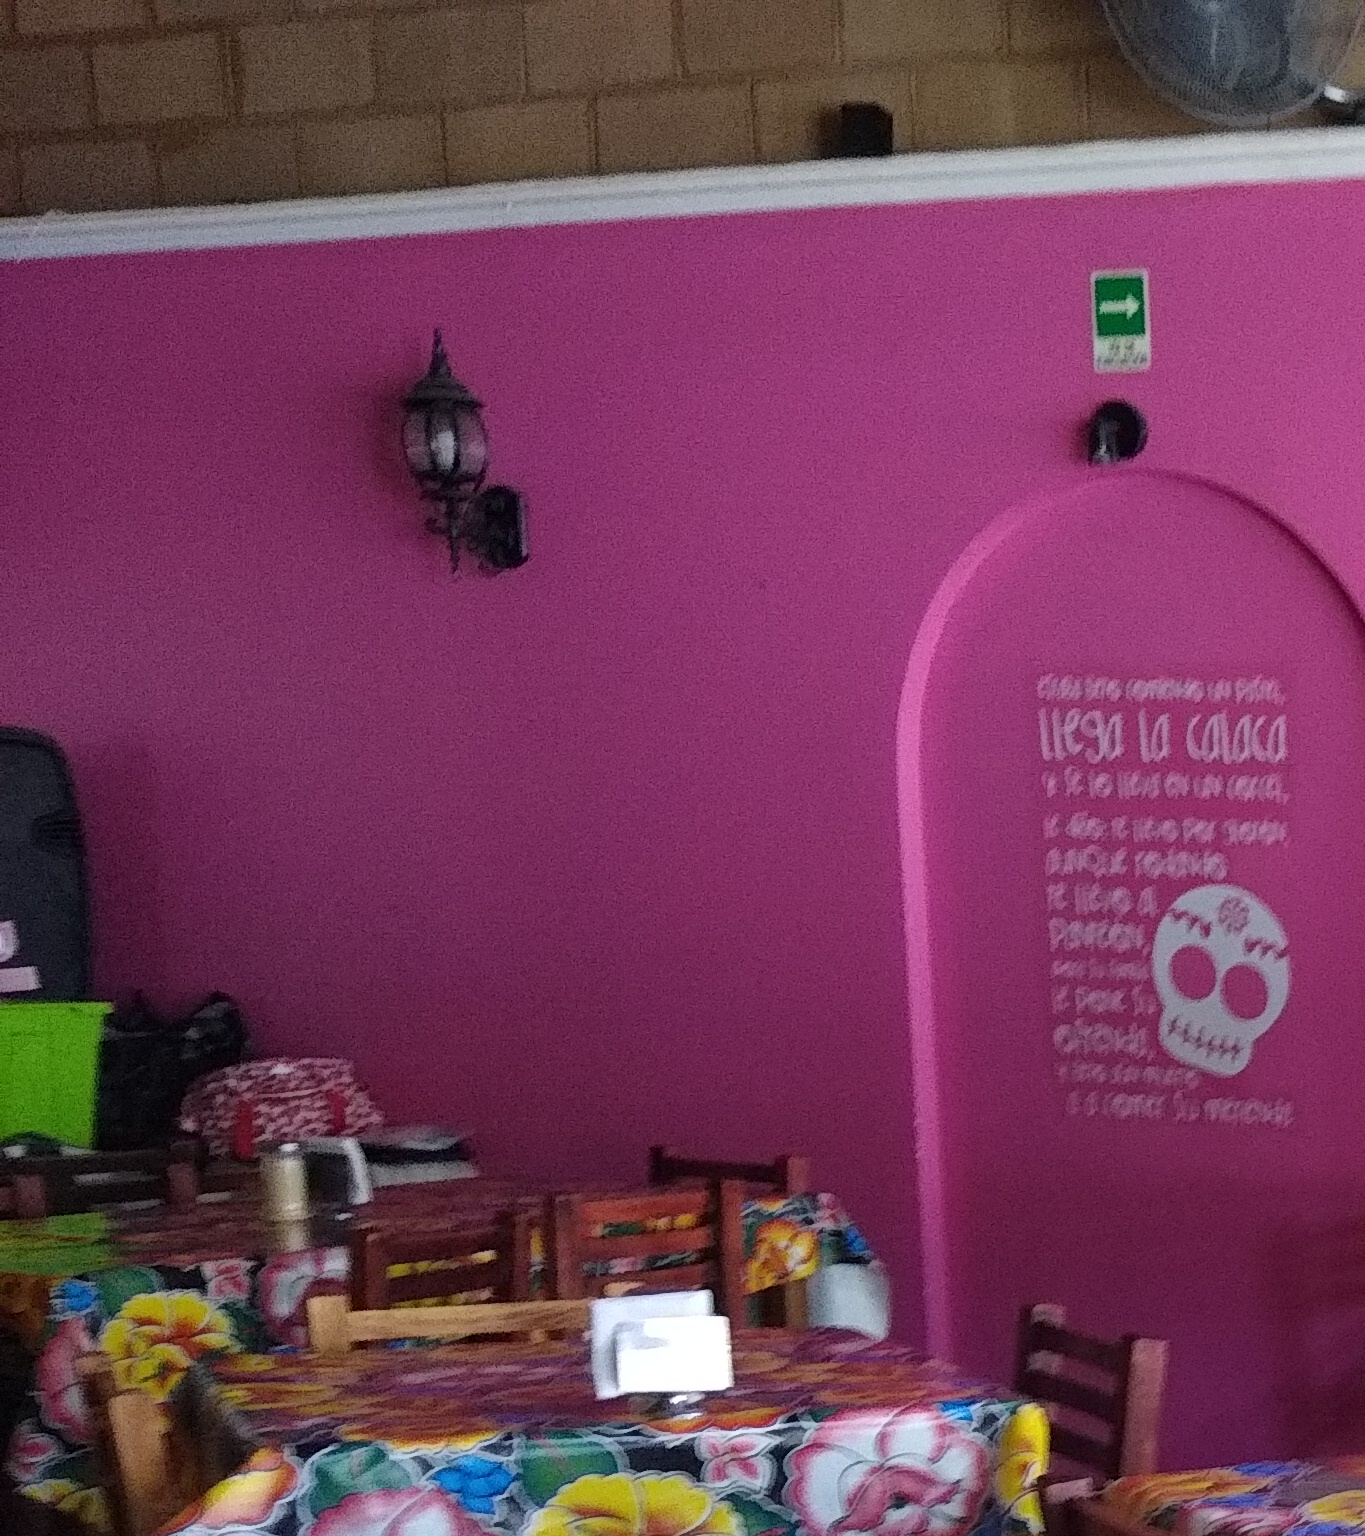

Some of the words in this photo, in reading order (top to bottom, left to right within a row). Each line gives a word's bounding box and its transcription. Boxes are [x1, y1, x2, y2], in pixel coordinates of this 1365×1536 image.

[1038, 707, 1125, 764] llega
[1138, 707, 1170, 763] la
[1185, 709, 1288, 765] calaca
